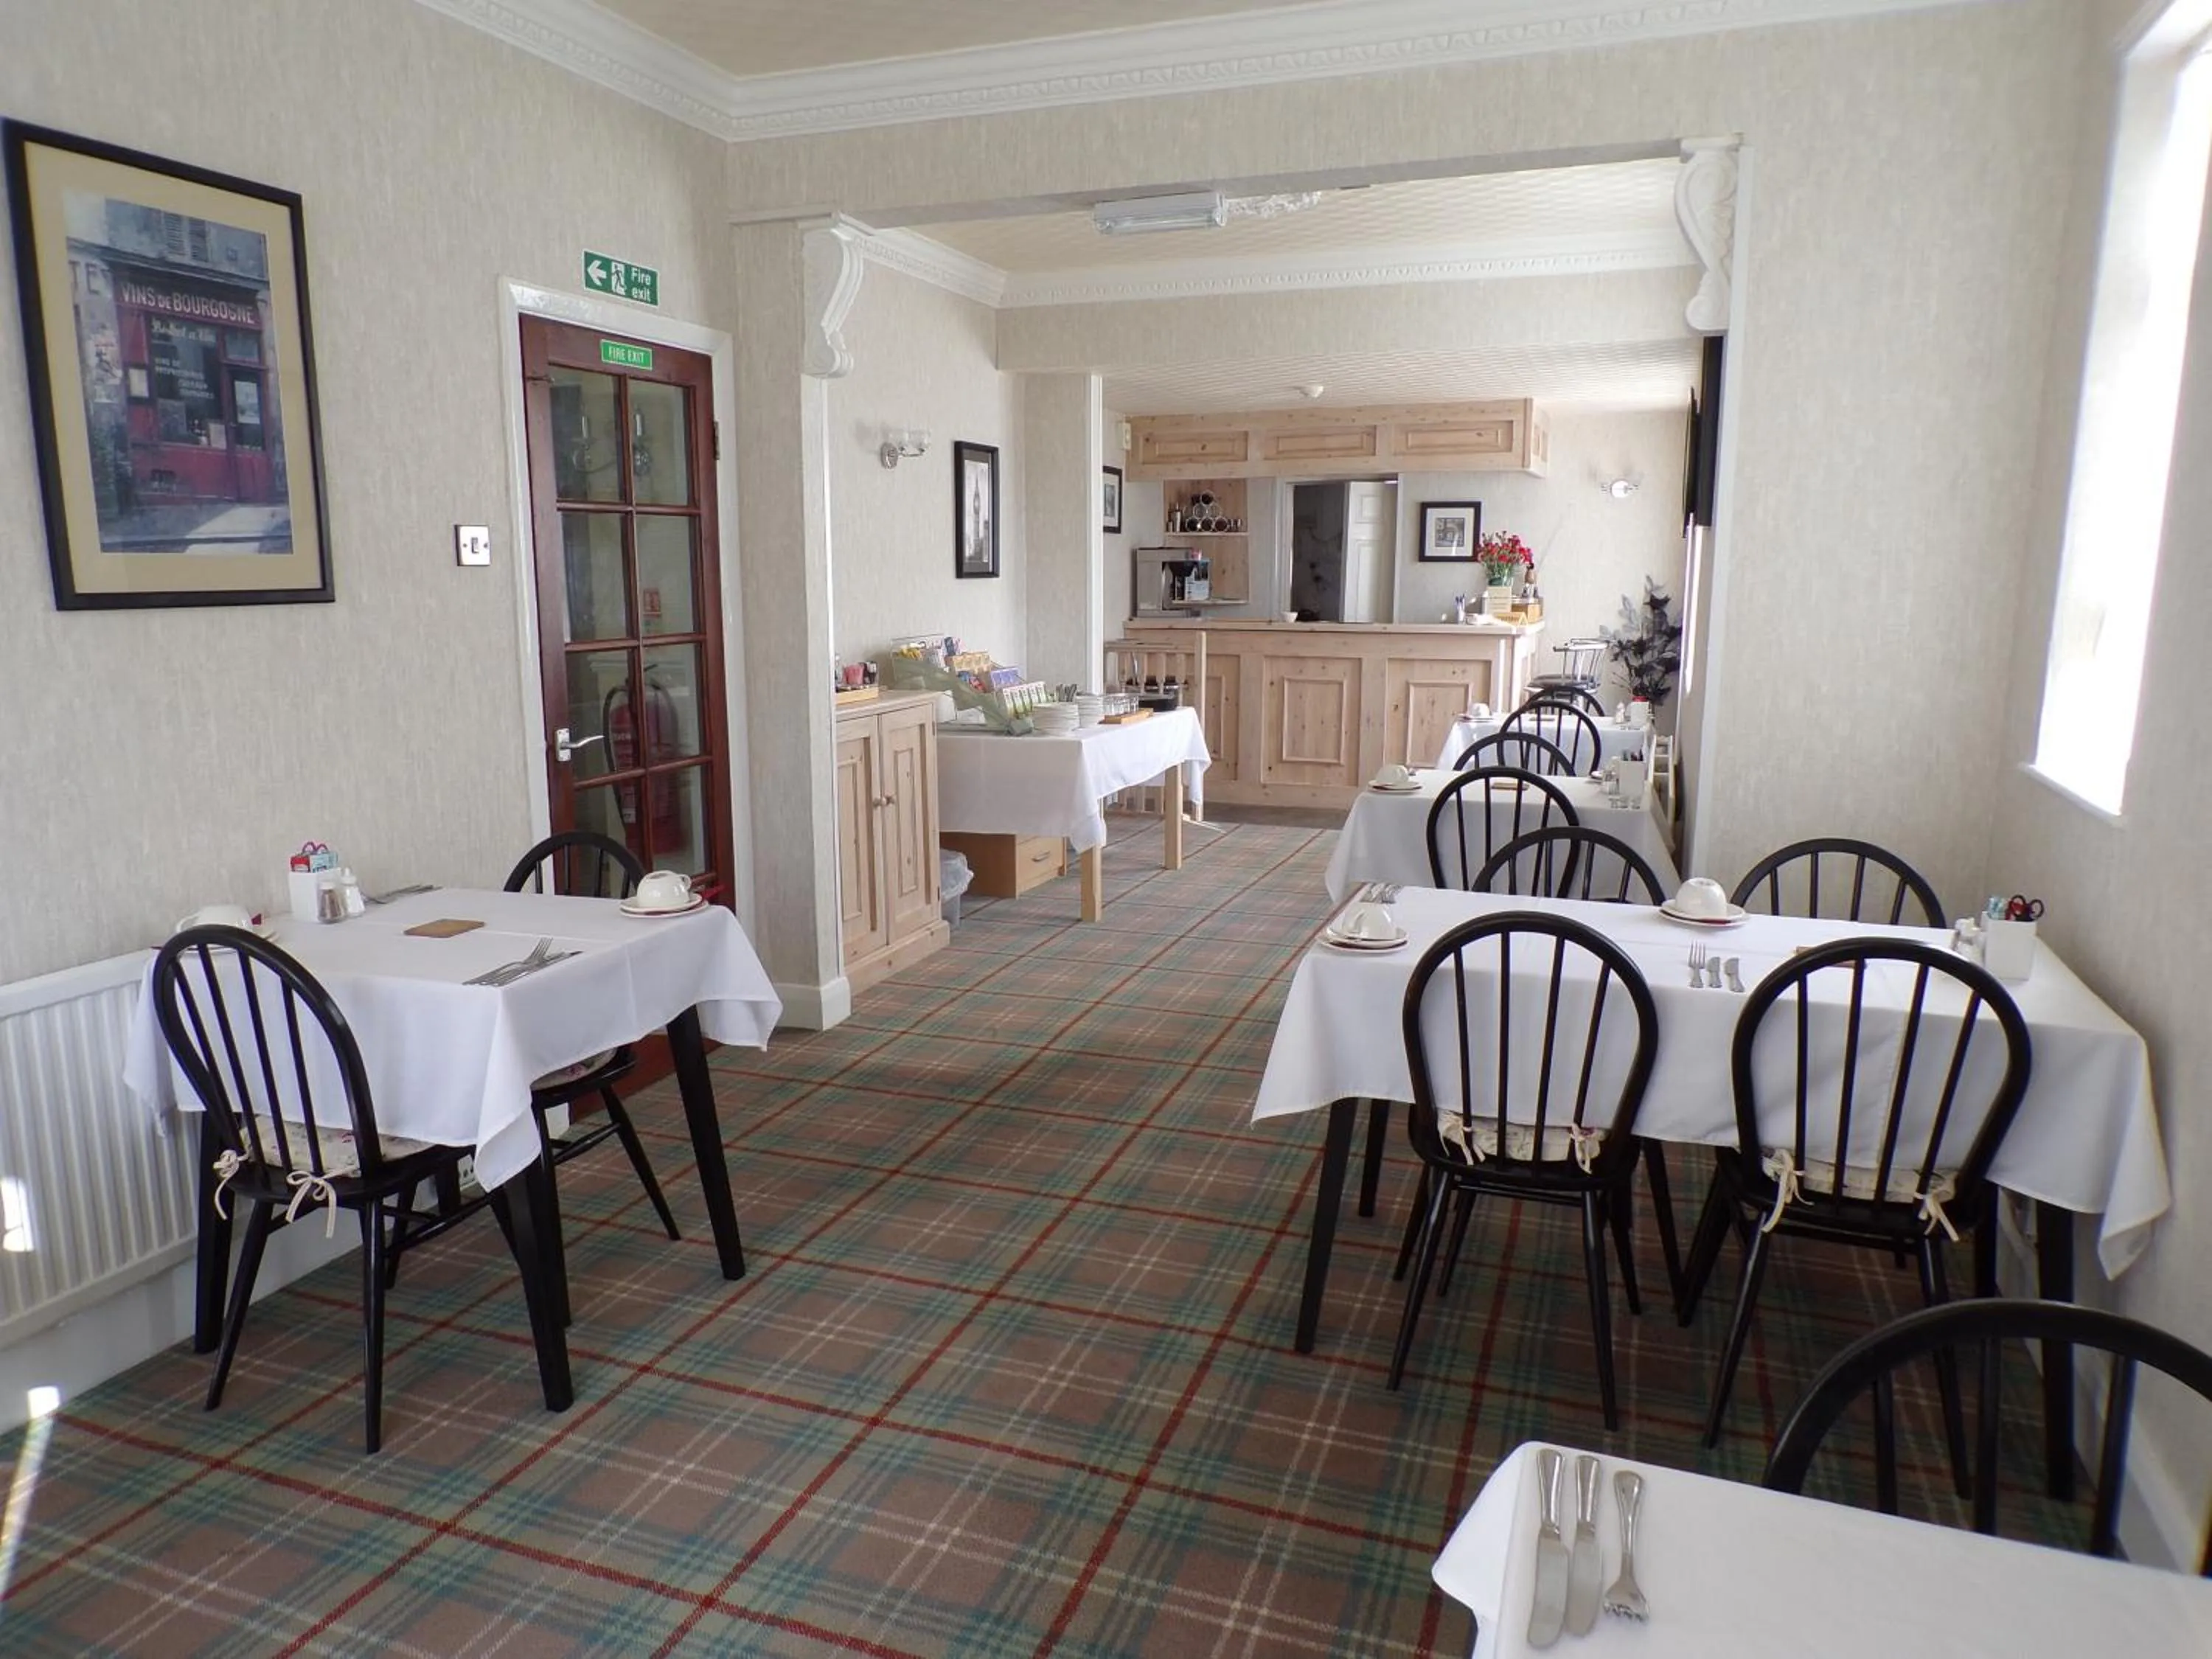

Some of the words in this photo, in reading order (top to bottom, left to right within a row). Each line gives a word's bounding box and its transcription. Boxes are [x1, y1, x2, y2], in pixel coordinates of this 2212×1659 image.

[630, 267, 651, 285] Fire
[120, 282, 156, 307] VINS
[173, 292, 255, 324] BOURGOGNE
[631, 286, 651, 302] exit
[608, 345, 626, 361] FIRE
[627, 349, 644, 364] EXIT
